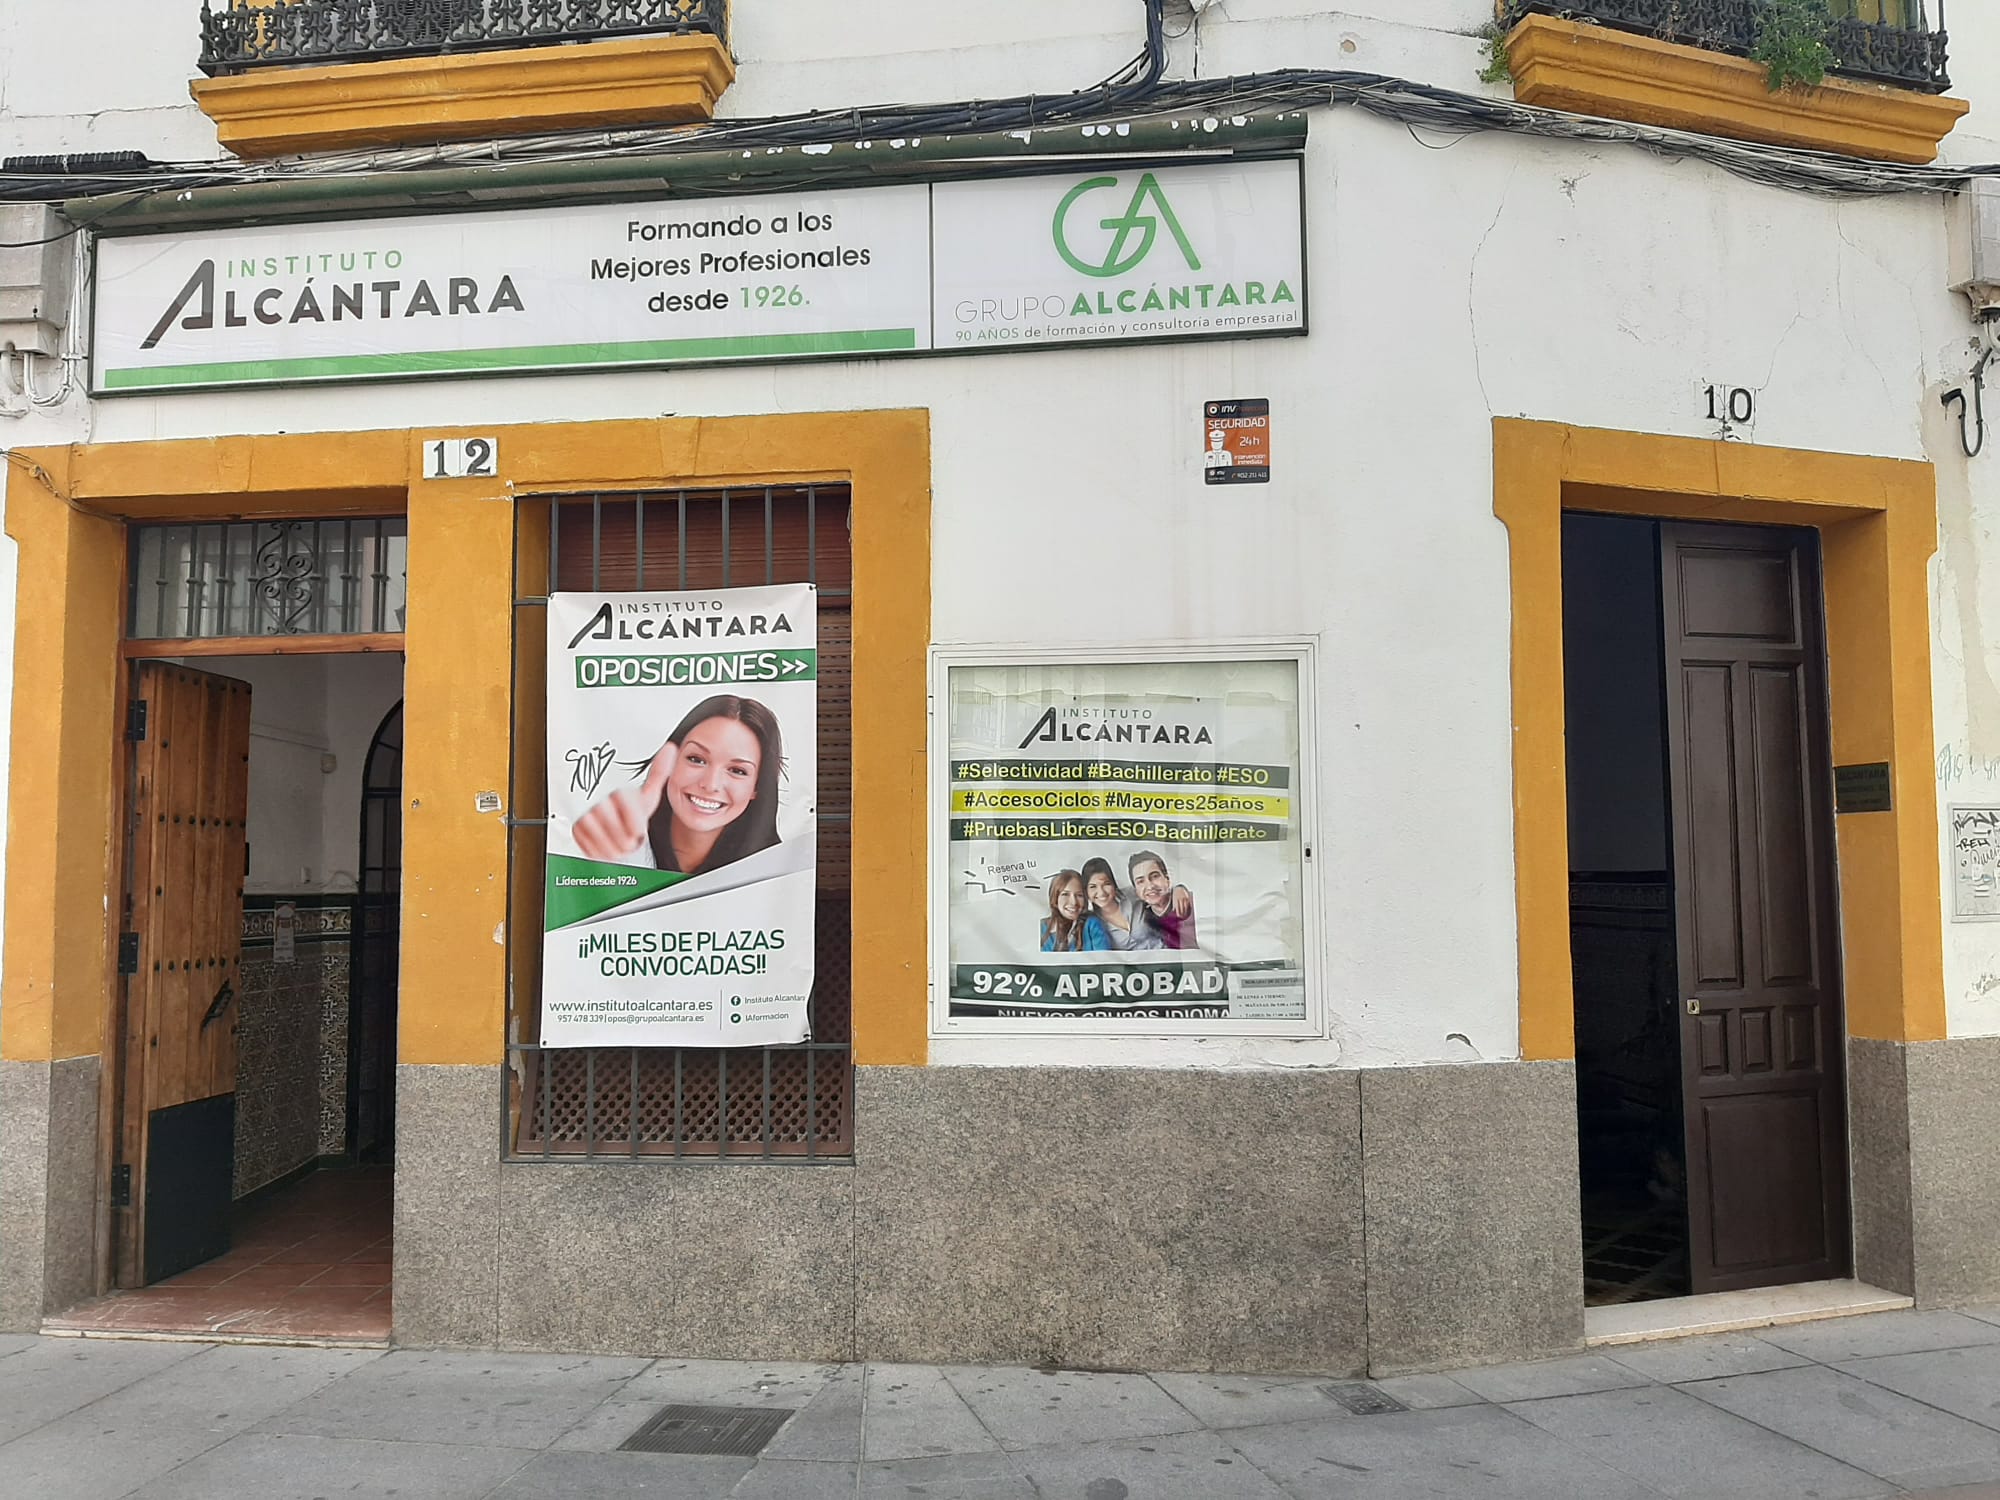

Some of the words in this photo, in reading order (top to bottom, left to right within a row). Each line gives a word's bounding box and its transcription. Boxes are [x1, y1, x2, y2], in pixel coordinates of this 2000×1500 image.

[626, 215, 763, 242] Formando
[770, 215, 788, 234] a
[797, 211, 833, 233] los
[227, 249, 404, 279] INSTITUTO
[590, 256, 691, 283] Mejores
[699, 246, 871, 274] Profesionales
[139, 258, 526, 350] ALCÁNTARA
[647, 288, 730, 313] desde
[739, 285, 811, 309] 1926.
[954, 295, 1066, 323] GRUPO
[1069, 280, 1296, 317] ALCÁNTARA
[955, 330, 972, 342] 90
[976, 327, 1020, 341] AÑOS
[1024, 326, 1041, 338] de
[1046, 322, 1116, 338] formación
[1119, 324, 1128, 335] y
[1214, 309, 1299, 328] empresarial
[1703, 384, 1753, 424] 10
[1207, 417, 1266, 430] SEGURIDAD
[433, 438, 492, 477] 12
[619, 600, 724, 615] INSTITUTO
[567, 602, 793, 650] ALCÁNTARA
[1018, 706, 1213, 749] ALCÁNTARA
[1062, 707, 1153, 720] INSTITUTO
[957, 762, 1083, 779] #Selectividad
[1087, 762, 1213, 782] #Bachillerato
[1216, 766, 1269, 785] #ESO
[964, 791, 1101, 808] #AccesoCiclos
[1105, 792, 1265, 813] #Mayores25años
[963, 820, 1267, 840] #PruebasLibresESO-Bachillerato
[555, 874, 589, 886] Líderes
[589, 875, 616, 886] desde
[617, 875, 638, 886] 1926
[987, 862, 1025, 875] Reserva
[1026, 859, 1037, 869] tu
[1002, 874, 1028, 884] Plaza
[578, 932, 658, 959] ¡¡MILES
[661, 932, 693, 952] DE
[697, 929, 786, 952] PLAZAS
[600, 954, 767, 977] CONVOCADAS!!
[972, 971, 1043, 998] 92%
[1053, 968, 1229, 998] APROBAD
[549, 999, 713, 1012] www.institutoalcantara.es
[557, 1014, 572, 1023] 957
[573, 1014, 589, 1023] 478
